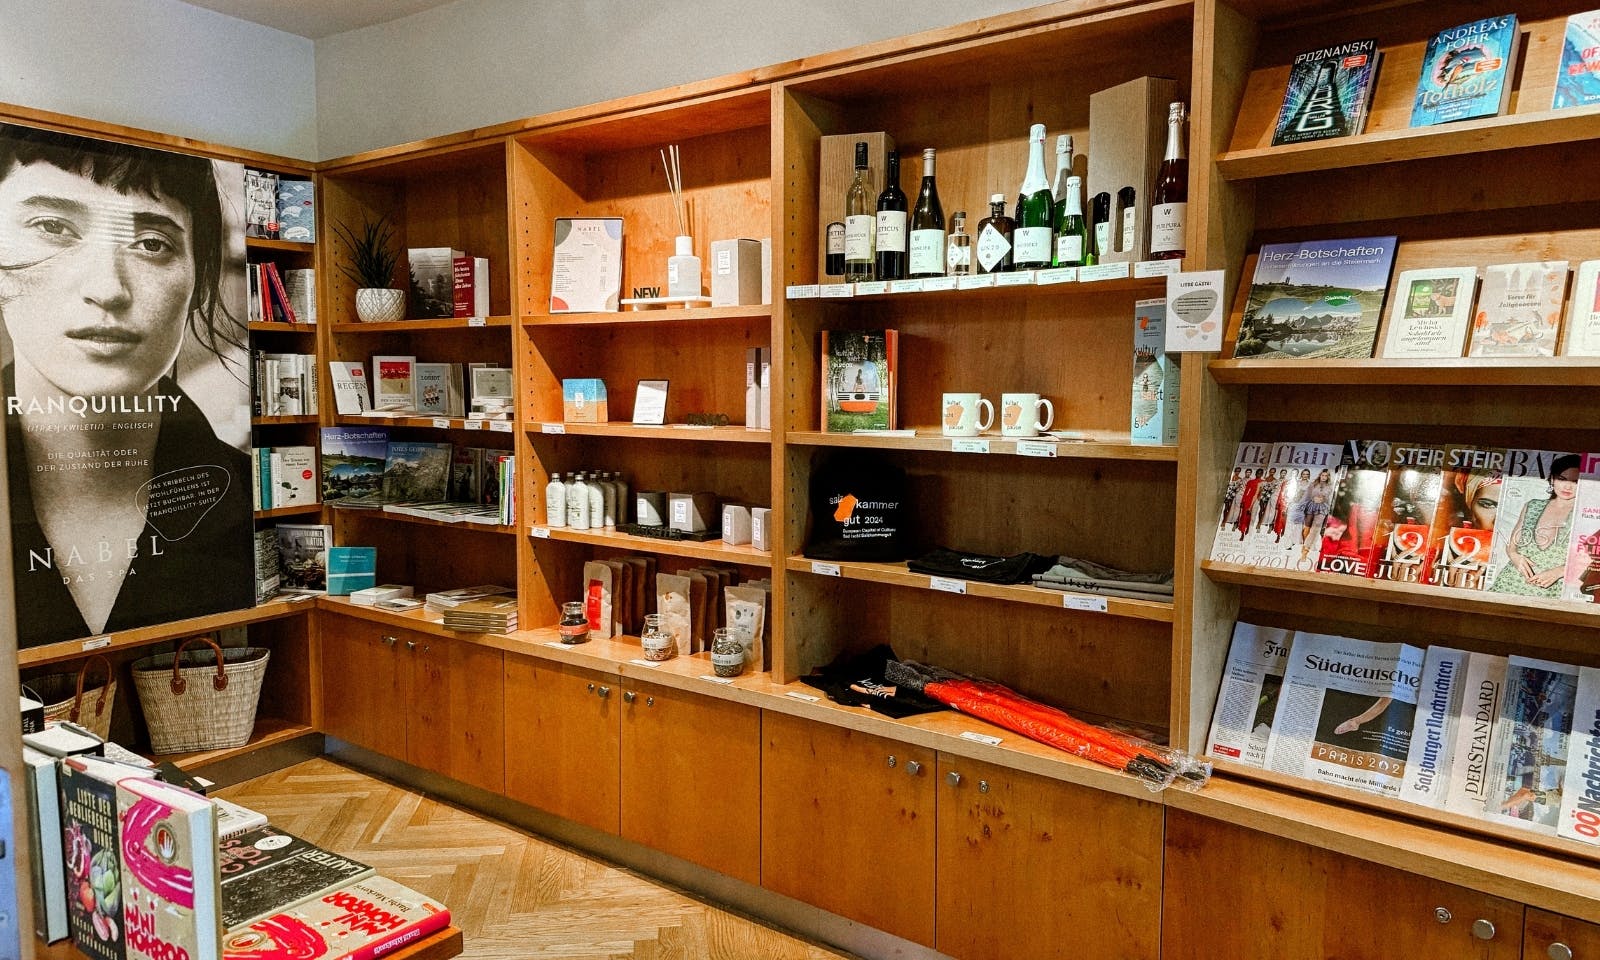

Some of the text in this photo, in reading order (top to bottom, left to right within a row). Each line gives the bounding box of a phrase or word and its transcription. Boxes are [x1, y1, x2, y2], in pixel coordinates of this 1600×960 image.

[1432, 18, 1508, 46] ANDREAS
[1297, 40, 1374, 62] POZNANSKI
[1418, 78, 1497, 107] Totholz
[1263, 246, 1384, 261] Herz-Botschaften
[633, 287, 660, 299] NEW
[337, 382, 367, 390] REGEN
[7, 395, 182, 418] RANQUILLITY
[112, 422, 153, 431] ENGLISCH
[47, 449, 138, 460] DIE QUALITÄT ODER
[1273, 444, 1335, 466] flair
[1448, 449, 1504, 469] STEIR
[36, 459, 149, 472] DER ZUSTAND DER RUHE
[1509, 450, 1560, 480] BA
[162, 476, 195, 487] KRIBBELN
[196, 471, 209, 480] DES
[149, 484, 199, 499] WOHLFÜHLENS
[206, 487, 220, 495] DER
[855, 499, 899, 509] kammer
[843, 514, 884, 527] gut 2024
[28, 535, 164, 572] NABEL
[1320, 557, 1367, 576] LOVE
[62, 567, 137, 585] DAS SPA
[1304, 654, 1420, 688] Süddeutsche
[1317, 768, 1334, 777] Bahn
[1334, 773, 1354, 782] macht
[1368, 779, 1397, 792] Milliarde
[77, 787, 111, 817] LISTE DER
